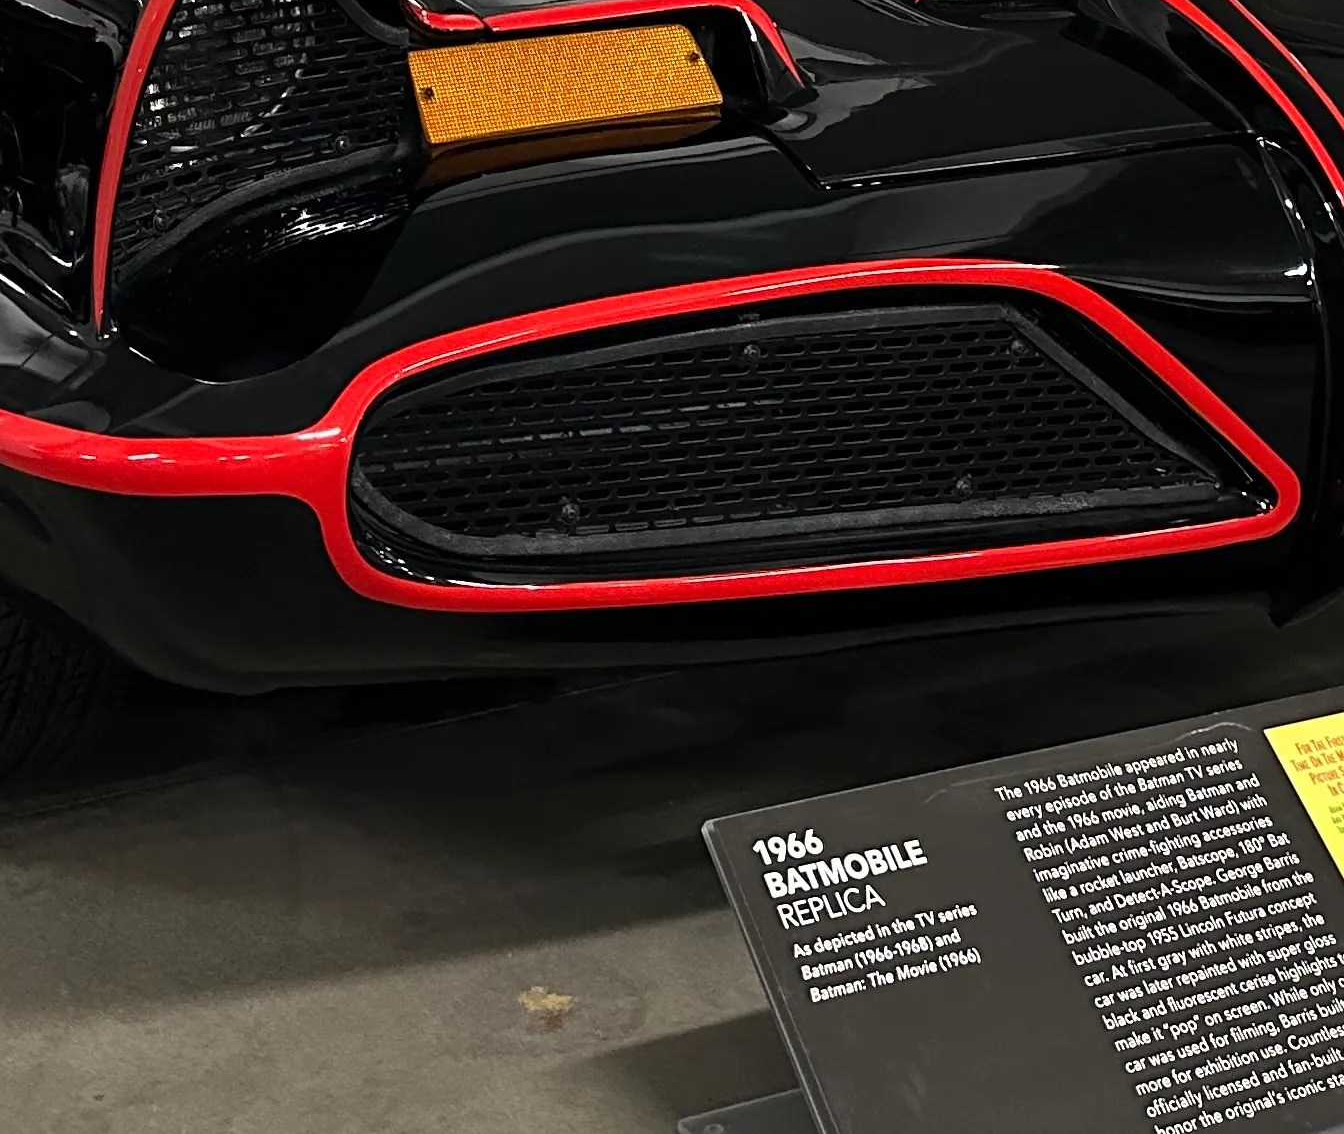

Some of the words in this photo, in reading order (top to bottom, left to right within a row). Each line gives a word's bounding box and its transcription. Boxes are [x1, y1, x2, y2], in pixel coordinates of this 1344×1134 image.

[994, 786, 1023, 801] The
[1024, 777, 1056, 795] 1966
[1056, 763, 1123, 788] Batmobile
[1124, 747, 1185, 775] appeared
[1184, 747, 1200, 759] in
[1200, 738, 1238, 756] nearly
[1006, 804, 1042, 821] every
[1045, 790, 1098, 815] episode
[1099, 784, 1113, 800] of
[1113, 782, 1136, 797] the
[1137, 772, 1185, 792] Batman
[1183, 765, 1203, 780] TV
[1206, 760, 1243, 776] series
[1016, 822, 1042, 842] and
[1042, 820, 1066, 835] the
[1067, 810, 1100, 829] 1966
[1101, 803, 1145, 822] movie,
[1146, 794, 1187, 812] aiding
[1185, 783, 1235, 802] Batman
[1235, 773, 1260, 791] and
[1023, 842, 1064, 862] Robin
[1064, 834, 1110, 854] (Adam
[1107, 824, 1145, 842] West
[1145, 815, 1171, 834] and
[1170, 810, 1201, 827] Burt
[1198, 800, 1240, 820] Ward)
[1239, 793, 1268, 811] with
[752, 829, 823, 865] 1966
[763, 839, 928, 898] BATMOBILE
[1032, 856, 1110, 882] imaginative
[1112, 834, 1202, 864] crime-fighting
[1202, 816, 1273, 842] accessories
[1042, 886, 1067, 903] like
[1069, 886, 1079, 897] a
[1079, 874, 1121, 894] rocket
[1118, 862, 1178, 884] launcher,
[1176, 848, 1239, 870] Batscope,
[1267, 833, 1291, 848] Bat
[777, 884, 886, 930] REPLICA
[1051, 907, 1088, 923] Turn,
[1088, 895, 1114, 915] and
[1113, 875, 1216, 909] Detect-A-Scope.
[1216, 863, 1264, 883] George
[1263, 852, 1300, 871] Barris
[1061, 925, 1095, 945] built
[1094, 921, 1117, 937] the
[1118, 905, 1167, 930] original
[1167, 898, 1199, 918] 1966
[1197, 883, 1262, 910] Batmobile
[1261, 878, 1293, 893] from
[1292, 871, 1314, 886] the
[794, 944, 812, 958] As
[814, 925, 875, 953] depicted
[875, 924, 891, 938] in
[891, 918, 915, 934] the
[914, 911, 934, 928] TV
[938, 905, 977, 923] series
[801, 958, 853, 981] Batman
[854, 935, 934, 969] (1966-1968)
[934, 928, 961, 947] and
[1071, 938, 1146, 966] bubble-top
[1147, 926, 1179, 946] 1955
[1178, 915, 1226, 938] Lincoln
[1224, 907, 1267, 926] Futura
[1267, 892, 1317, 915] concept
[1084, 972, 1110, 987] car.
[1111, 965, 1129, 980] At
[1127, 957, 1157, 975] first
[1157, 951, 1187, 971] gray
[1188, 940, 1217, 959] with
[1217, 933, 1254, 951] white
[1255, 921, 1303, 942] stripes,
[1302, 913, 1325, 928] the
[810, 979, 866, 1003] Batman:
[866, 971, 894, 988] The
[896, 960, 938, 981] Movie
[938, 947, 981, 972] (1966)
[1094, 993, 1115, 1008] car
[1116, 986, 1144, 1002] was
[1142, 977, 1173, 995] later
[1175, 956, 1237, 987] repainted
[1237, 950, 1266, 969] with
[1266, 943, 1302, 962] super
[1303, 934, 1337, 955] gloss
[1102, 1008, 1141, 1030] black
[1141, 999, 1168, 1020] and
[1166, 982, 1239, 1012] fluorescent
[1239, 974, 1277, 993] cerise
[1275, 956, 1338, 982] highlights
[1114, 1031, 1151, 1052] make
[1150, 1027, 1165, 1041] it
[1204, 1013, 1223, 1026] on
[1223, 1000, 1271, 1021] screen.
[1268, 986, 1309, 1007] While
[1310, 978, 1337, 996] only
[1125, 1058, 1146, 1073] car
[1148, 1050, 1175, 1066] was
[1176, 1036, 1210, 1059] used
[1209, 1033, 1230, 1049] for
[1230, 1021, 1280, 1043] filming,
[1278, 1008, 1318, 1029] Barris
[1135, 1076, 1172, 1096] more
[1171, 1069, 1192, 1085] for
[1195, 1051, 1259, 1079] exhibition
[1260, 1044, 1288, 1059] use.
[1146, 1090, 1203, 1118] officially
[1202, 1070, 1261, 1100] licensed
[1262, 1062, 1288, 1084] and
[1287, 1047, 1344, 1075] fan-built
[1154, 1118, 1198, 1134] honor
[1198, 1111, 1223, 1127] the
[1284, 1079, 1326, 1101] iconic
